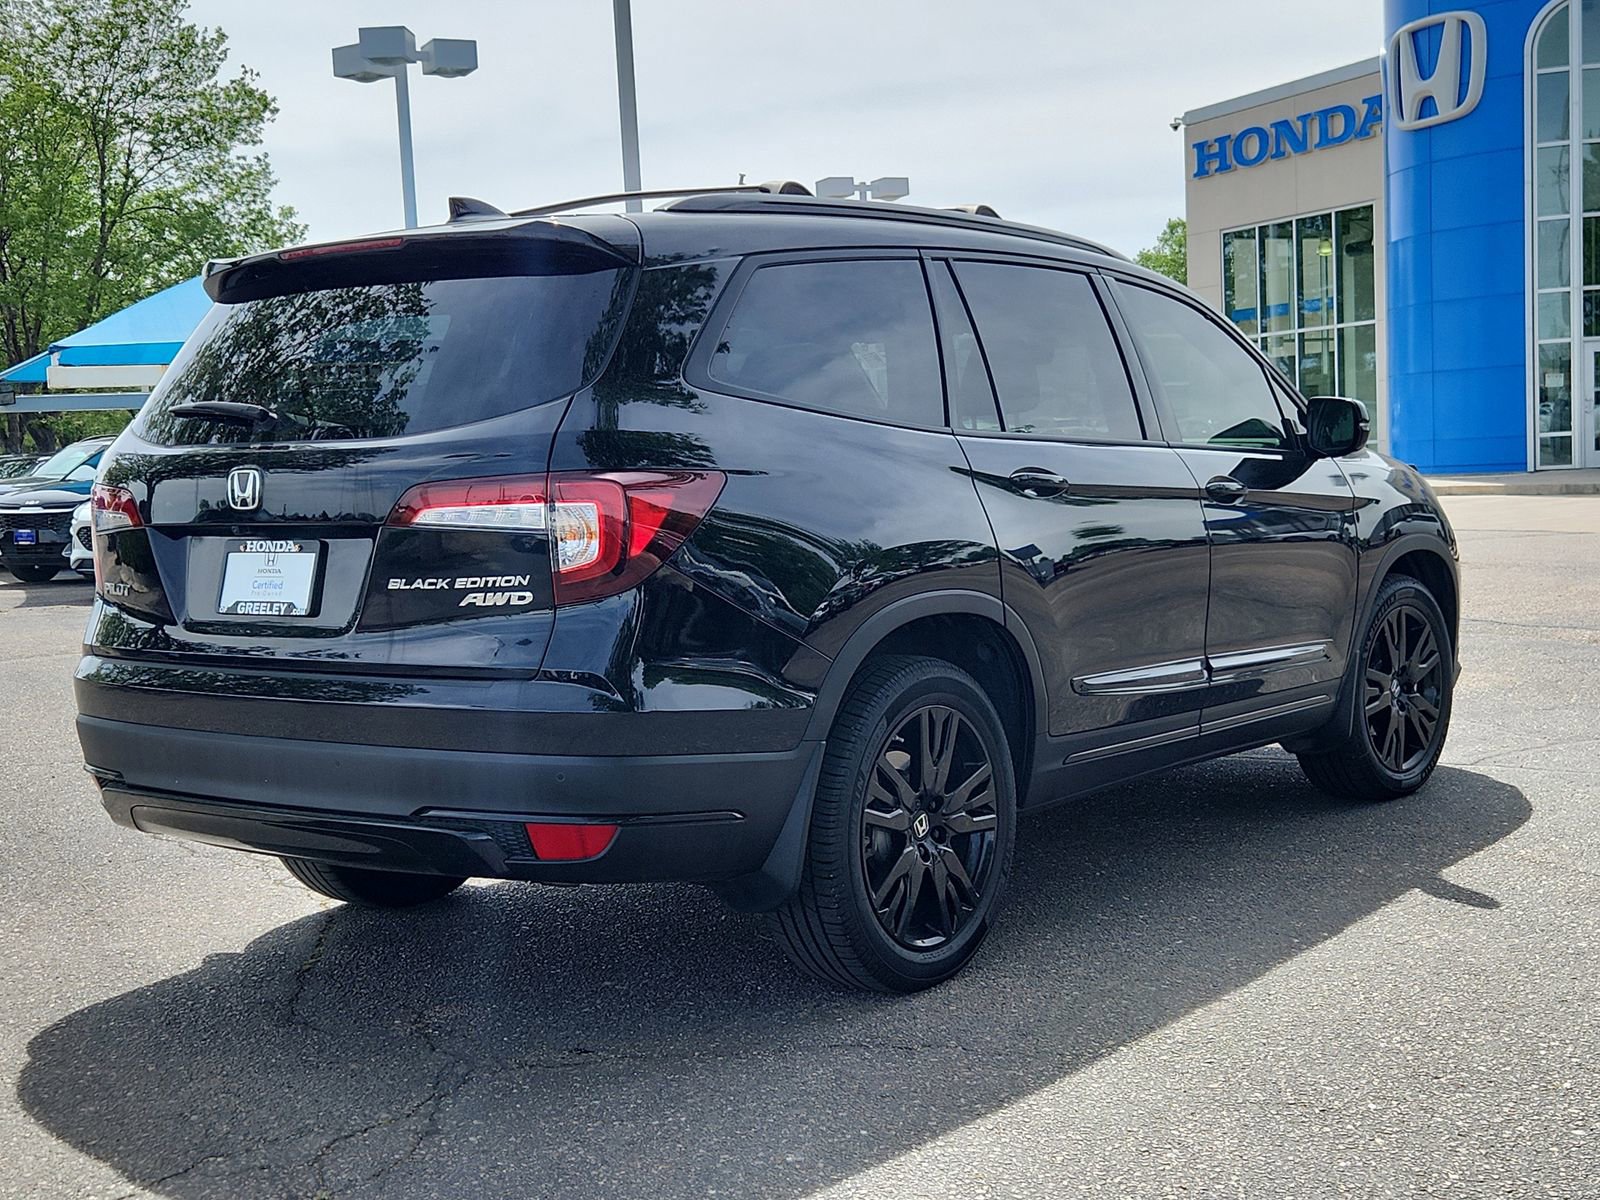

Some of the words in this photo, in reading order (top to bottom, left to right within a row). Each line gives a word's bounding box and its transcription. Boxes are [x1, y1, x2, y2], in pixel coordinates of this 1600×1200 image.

[1192, 94, 1383, 178] HONDA
[245, 541, 296, 552] HONDA
[103, 582, 130, 597] PILOT
[252, 579, 284, 590] Certified
[387, 578, 451, 590] BLACK
[454, 574, 530, 589] EDITION
[458, 591, 534, 607] AWD
[237, 602, 288, 615] GREELEY
